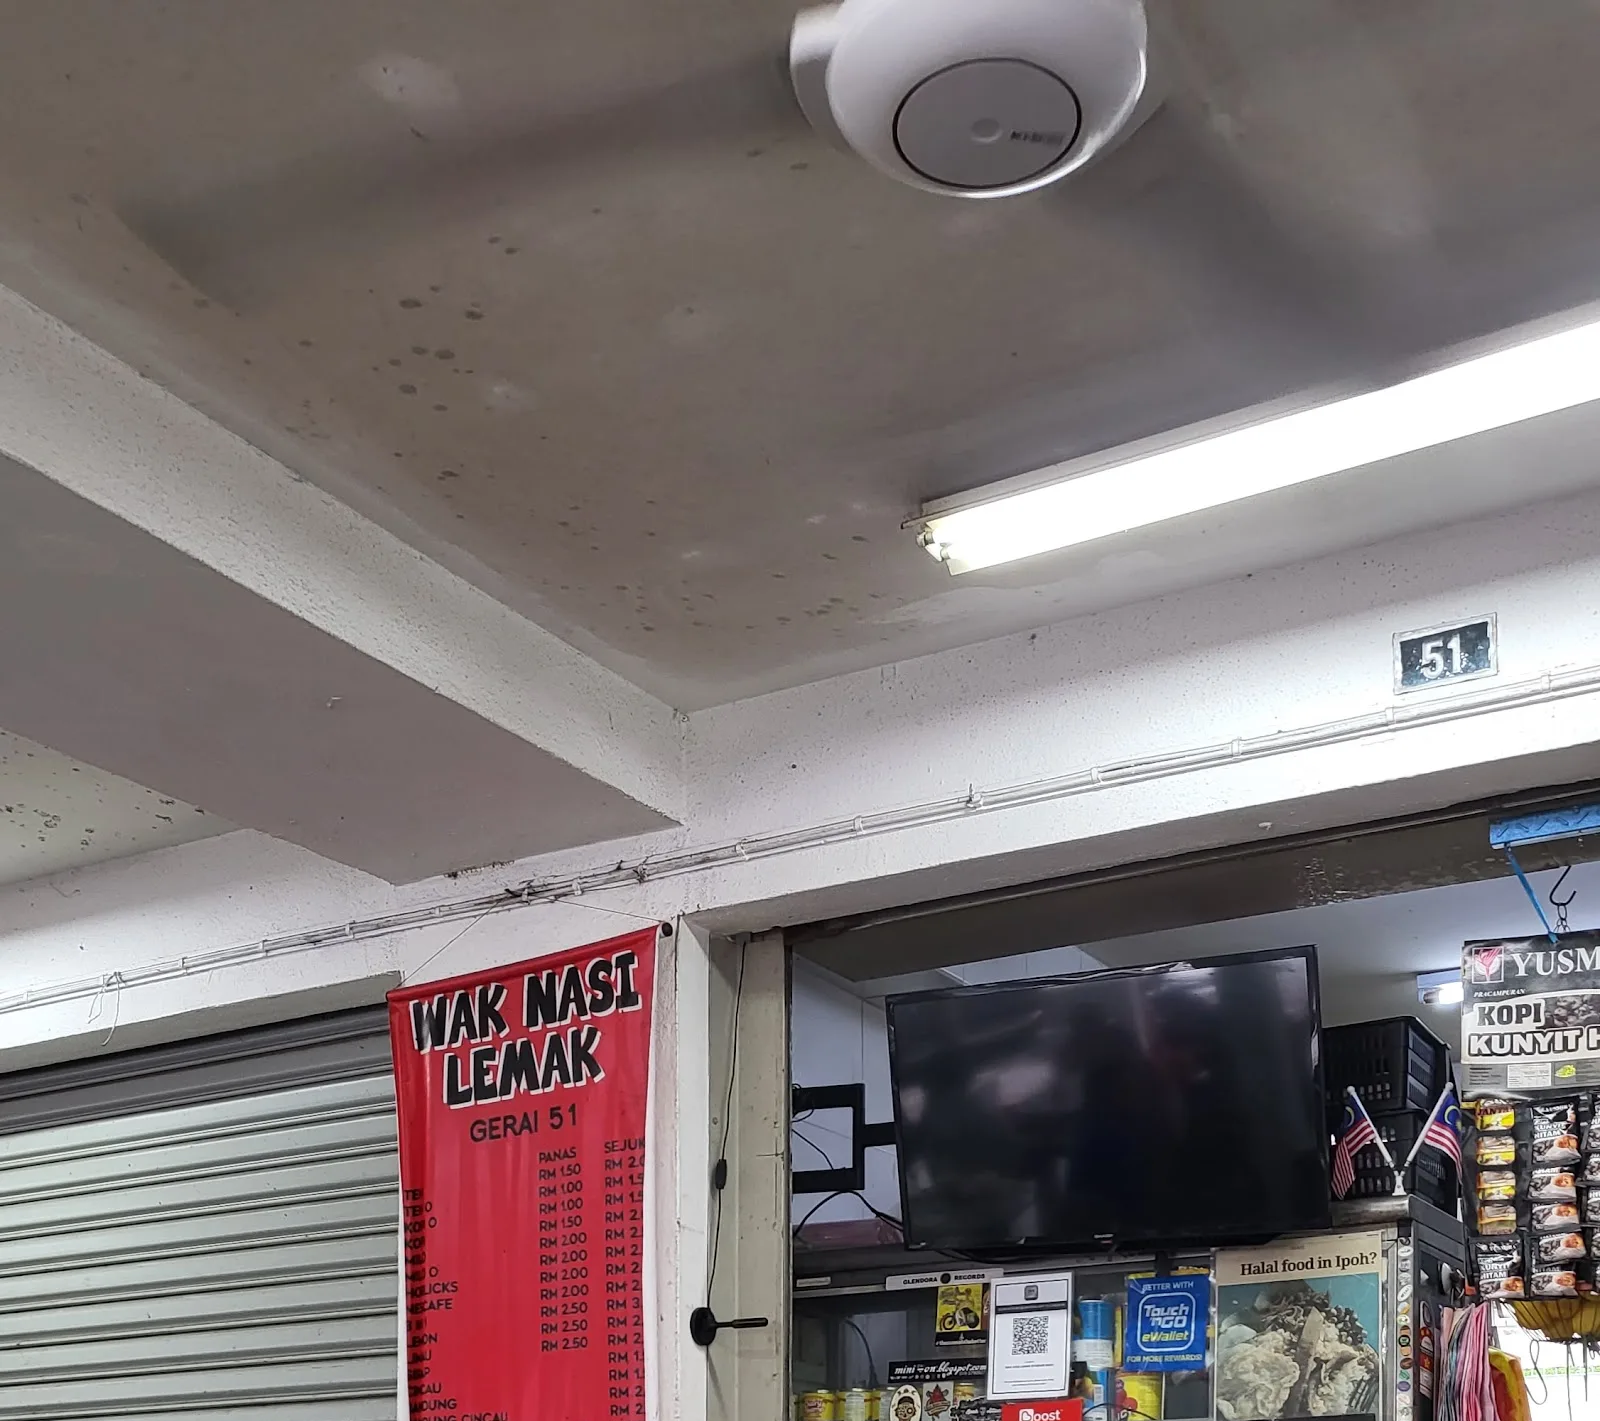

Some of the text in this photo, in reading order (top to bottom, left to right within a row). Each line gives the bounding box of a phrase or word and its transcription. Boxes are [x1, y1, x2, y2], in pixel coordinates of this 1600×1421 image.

[1422, 634, 1461, 679] 51
[410, 950, 642, 1054] WAK NASI
[1477, 1002, 1542, 1026] KOPI
[1469, 1028, 1583, 1056] KUNYIT
[443, 1025, 605, 1109] LEMAK
[470, 1103, 577, 1142] GERAI 51
[539, 1147, 577, 1164] PANAS
[539, 1168, 557, 1180] RM
[605, 1159, 622, 1171] RM
[539, 1185, 557, 1197] RM
[605, 1176, 623, 1188] RM
[539, 1203, 557, 1214] RM
[605, 1194, 623, 1205] RM
[540, 1220, 557, 1232] RM
[540, 1232, 587, 1249] RM 2.00
[540, 1250, 587, 1266] RM 2.00
[1240, 1252, 1377, 1276] Halal food in Ipoh?
[540, 1267, 588, 1283] RM 2.00
[903, 1274, 985, 1286] GLENDORA RECORDS
[541, 1284, 588, 1300] RM 2.00
[1142, 1280, 1194, 1292] BETTER WITH
[541, 1302, 588, 1318] RM 2.50
[1144, 1303, 1190, 1318] Touch
[541, 1319, 588, 1335] RM 2.50
[541, 1337, 588, 1352] RM 2.50
[1142, 1331, 1189, 1342] eWallet
[1126, 1355, 1141, 1363] FOR
[1143, 1355, 1162, 1363] MORE
